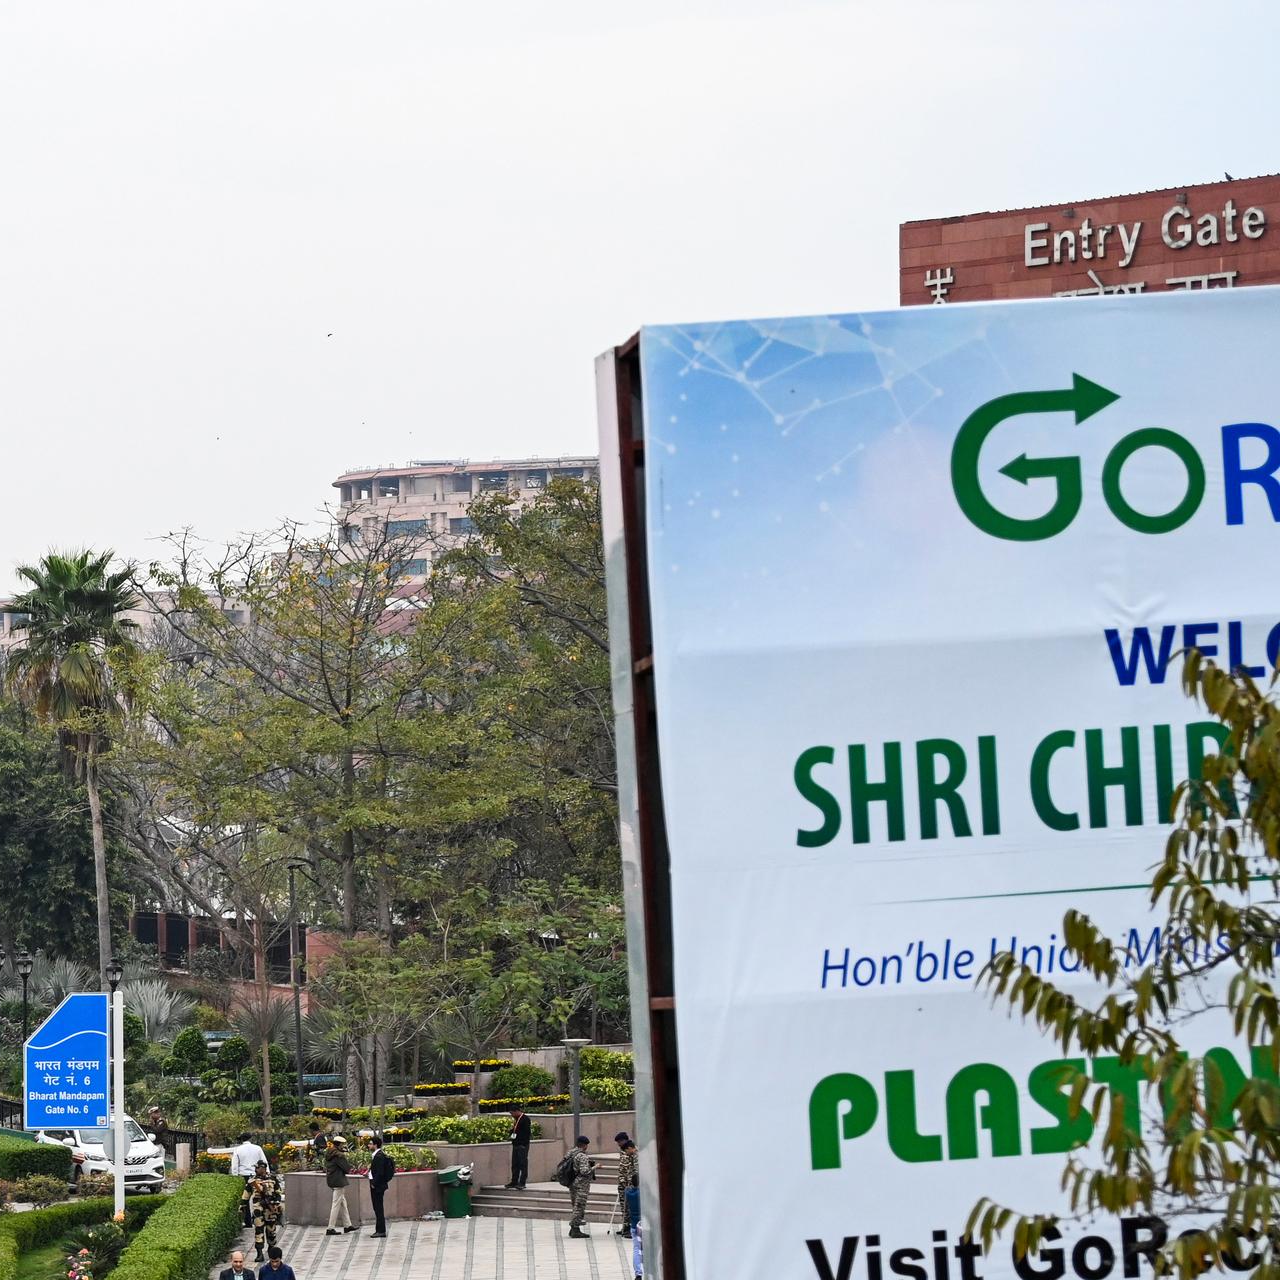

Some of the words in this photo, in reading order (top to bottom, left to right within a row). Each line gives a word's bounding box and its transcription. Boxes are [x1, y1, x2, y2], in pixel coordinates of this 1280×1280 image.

[1024, 218, 1142, 268] Entry
[1161, 199, 1266, 249] Gate
[1103, 620, 1280, 687] WEL
[793, 734, 1002, 849] SHRI
[988, 932, 1100, 978] Unio
[33, 1060, 61, 1071] भारत
[66, 1056, 100, 1071] मंडपम
[42, 1072, 61, 1086] गेट
[65, 1072, 78, 1086] नं.
[83, 1076, 91, 1086] 6
[29, 1091, 58, 1101] Bharat
[58, 1091, 105, 1102] Mandapam
[45, 1105, 65, 1114] Gate
[66, 1105, 82, 1114] No.
[83, 1104, 89, 1114] 6
